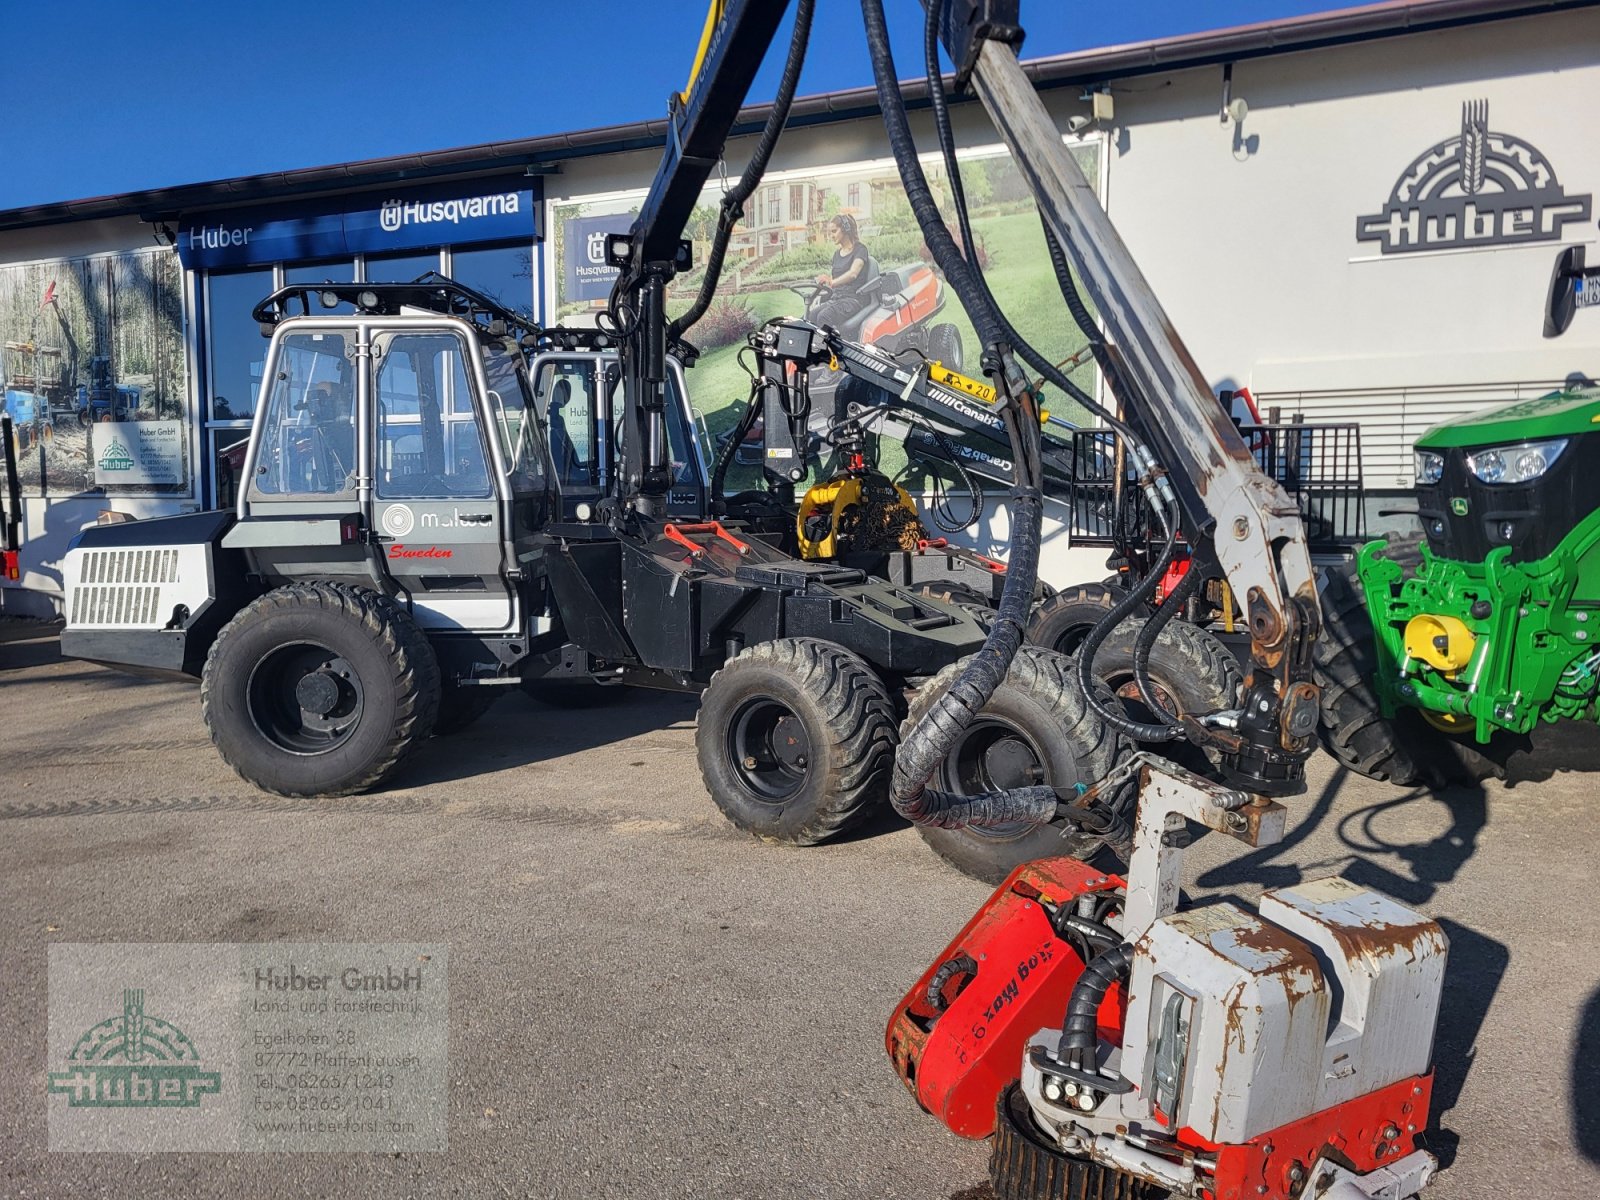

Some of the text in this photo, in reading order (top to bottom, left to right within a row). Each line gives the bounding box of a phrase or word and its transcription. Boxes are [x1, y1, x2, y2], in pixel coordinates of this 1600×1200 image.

[404, 193, 519, 225] Husqvarna
[1364, 201, 1584, 246] Huber
[189, 224, 253, 250] Huber
[976, 385, 990, 398] 20
[570, 406, 588, 417] Hub
[954, 402, 993, 425] Cranab
[100, 459, 133, 470] Huber
[973, 450, 1011, 471] Cranab
[666, 490, 696, 504] lwa
[388, 544, 453, 559] Sweden
[983, 977, 1019, 1023] Max
